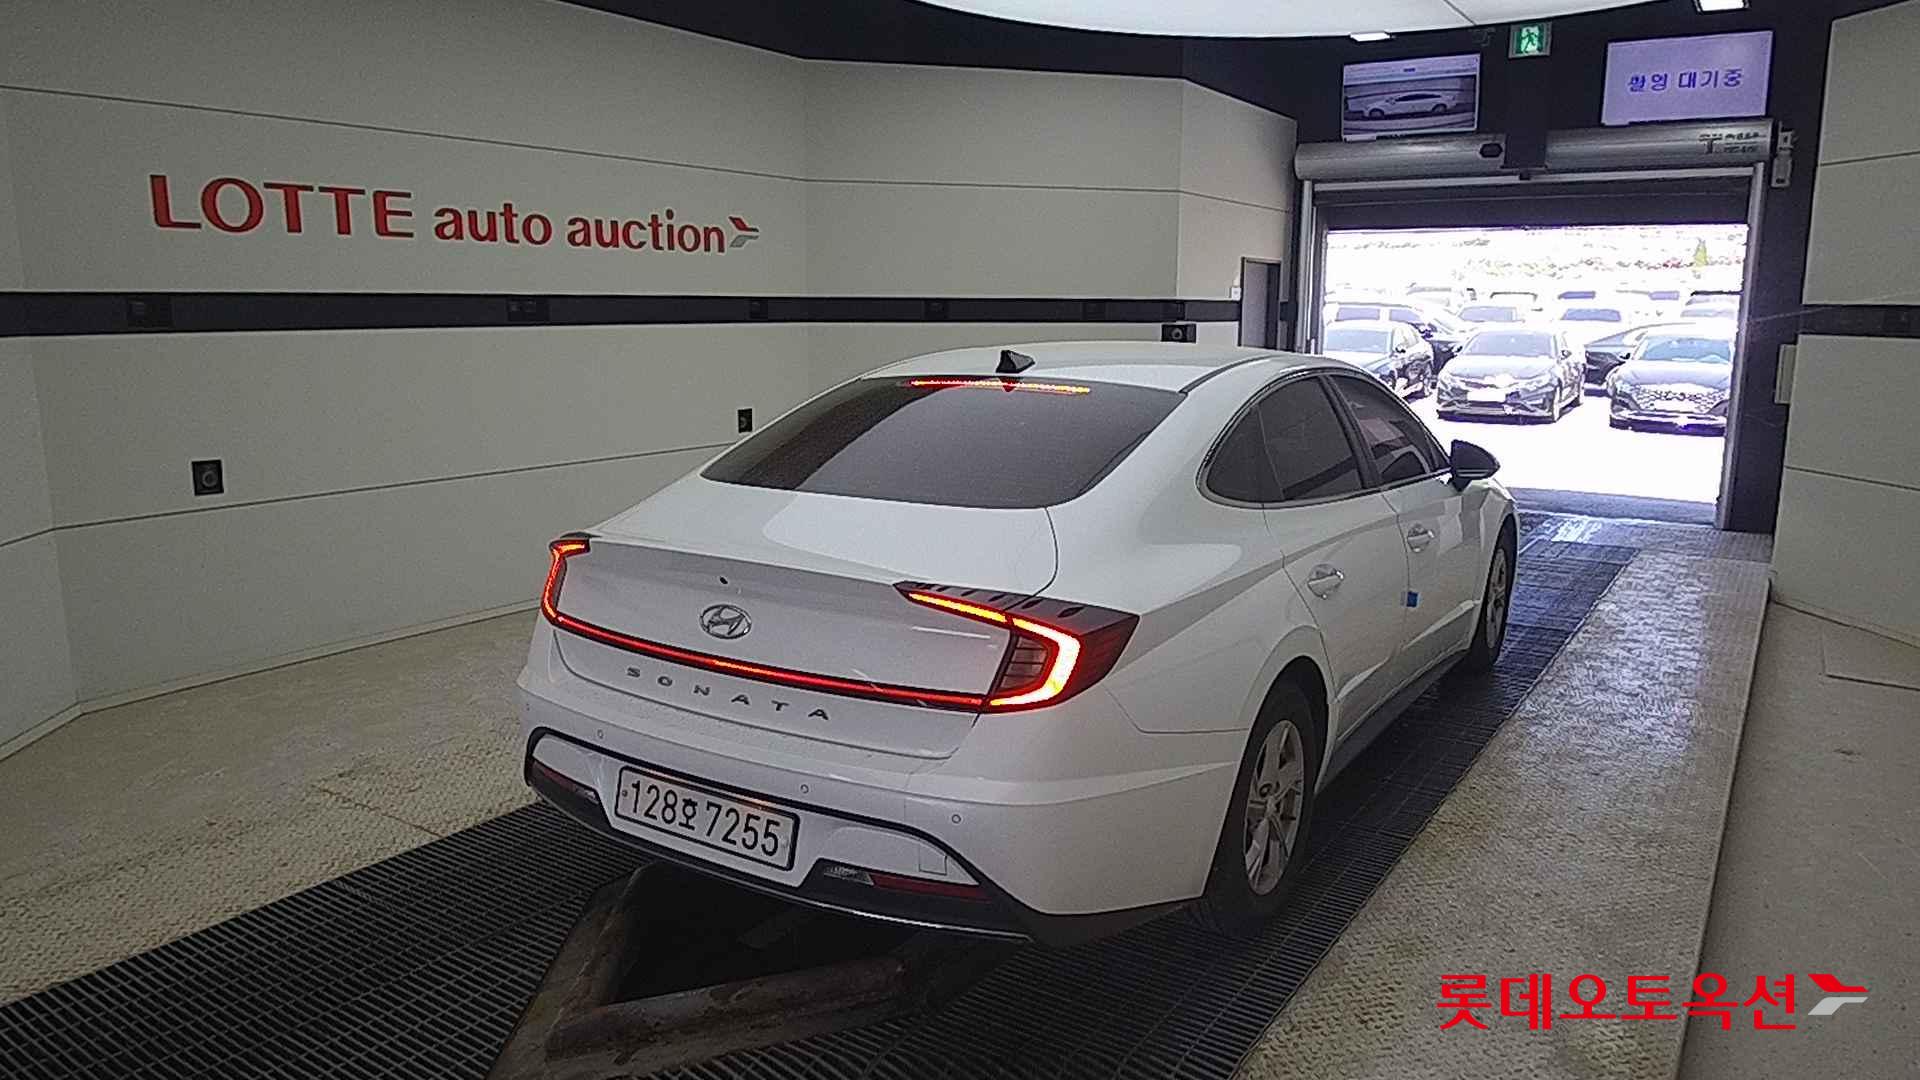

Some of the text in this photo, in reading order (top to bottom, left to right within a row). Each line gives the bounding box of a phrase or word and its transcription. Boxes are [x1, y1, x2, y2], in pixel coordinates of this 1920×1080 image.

[1678, 68, 1742, 89] 대기중
[149, 174, 726, 254] LOTTE auto auction
[626, 666, 829, 721] SONATA
[705, 801, 781, 857] 7255
